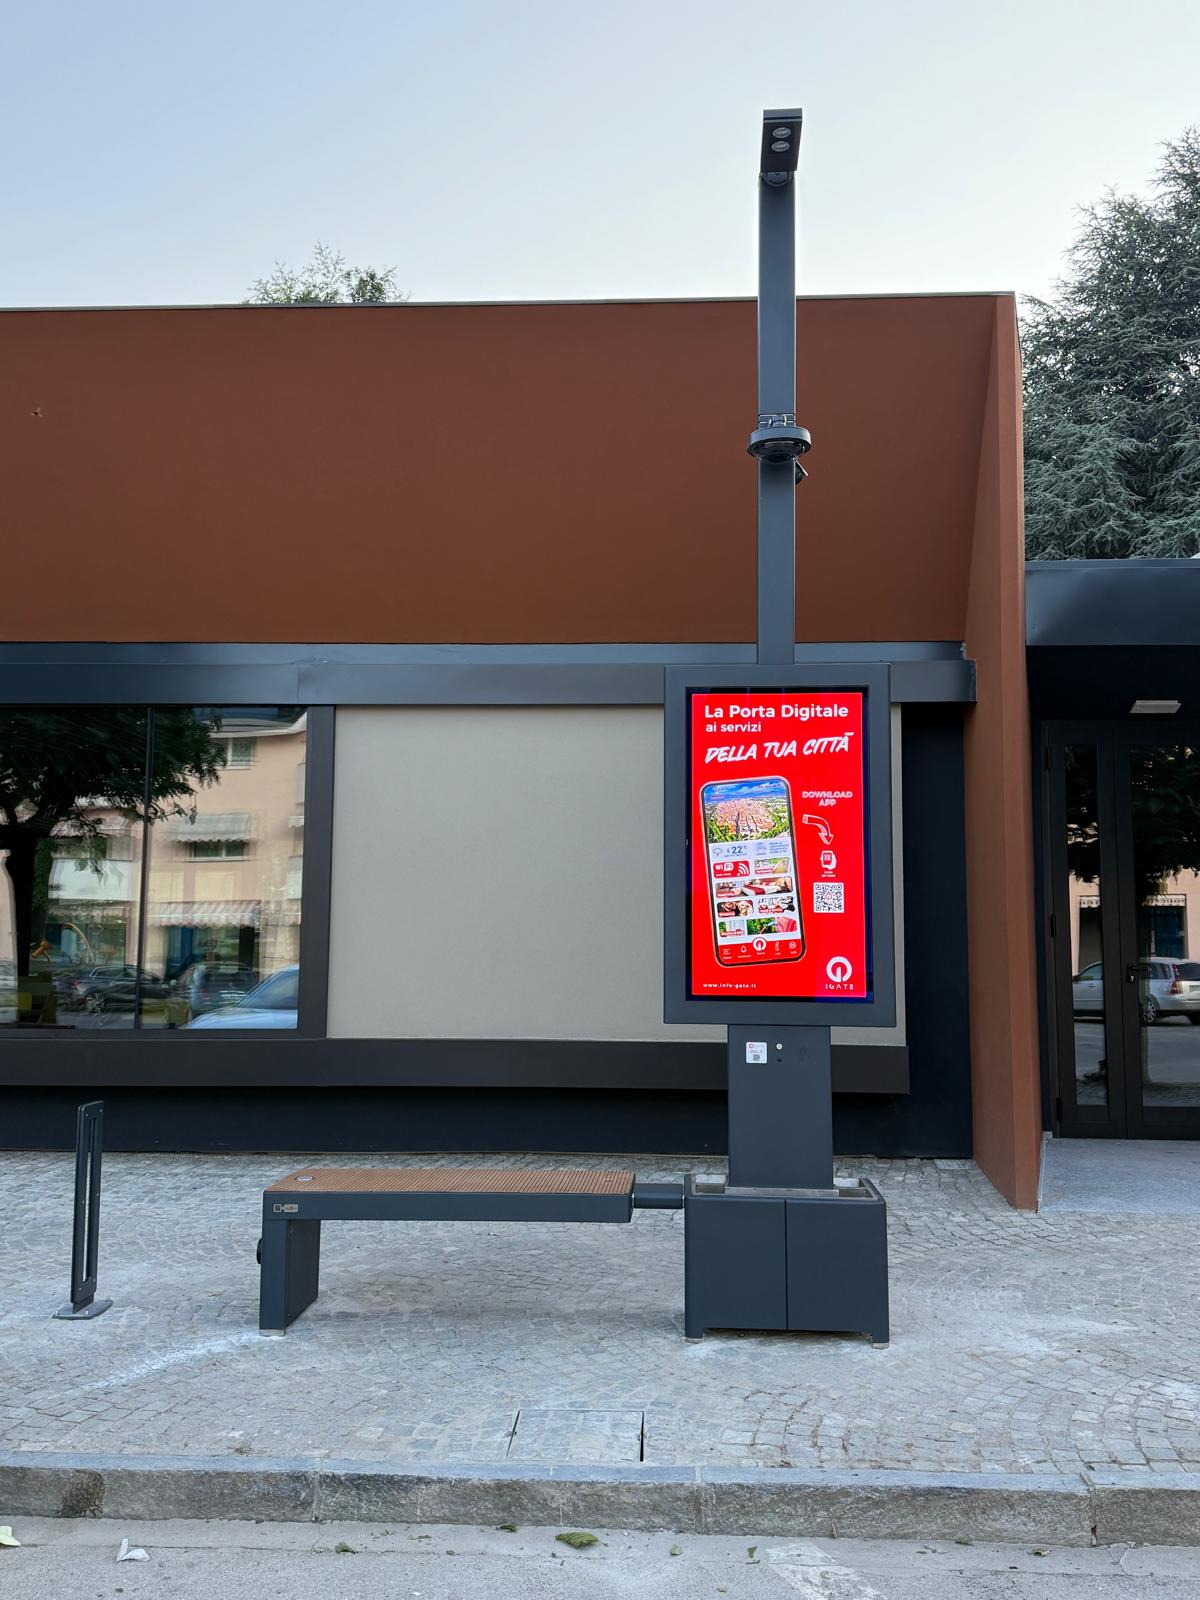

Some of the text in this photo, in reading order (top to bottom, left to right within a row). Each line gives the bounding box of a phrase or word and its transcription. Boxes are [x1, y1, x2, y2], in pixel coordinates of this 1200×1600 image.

[704, 703, 849, 721] La Porta Digitale
[705, 721, 762, 732] ai servizi
[704, 743, 757, 764] DELLA
[763, 740, 797, 758] TUA
[802, 790, 853, 798] DOWNLOAD
[818, 799, 837, 807] APP
[731, 846, 743, 854] 22
